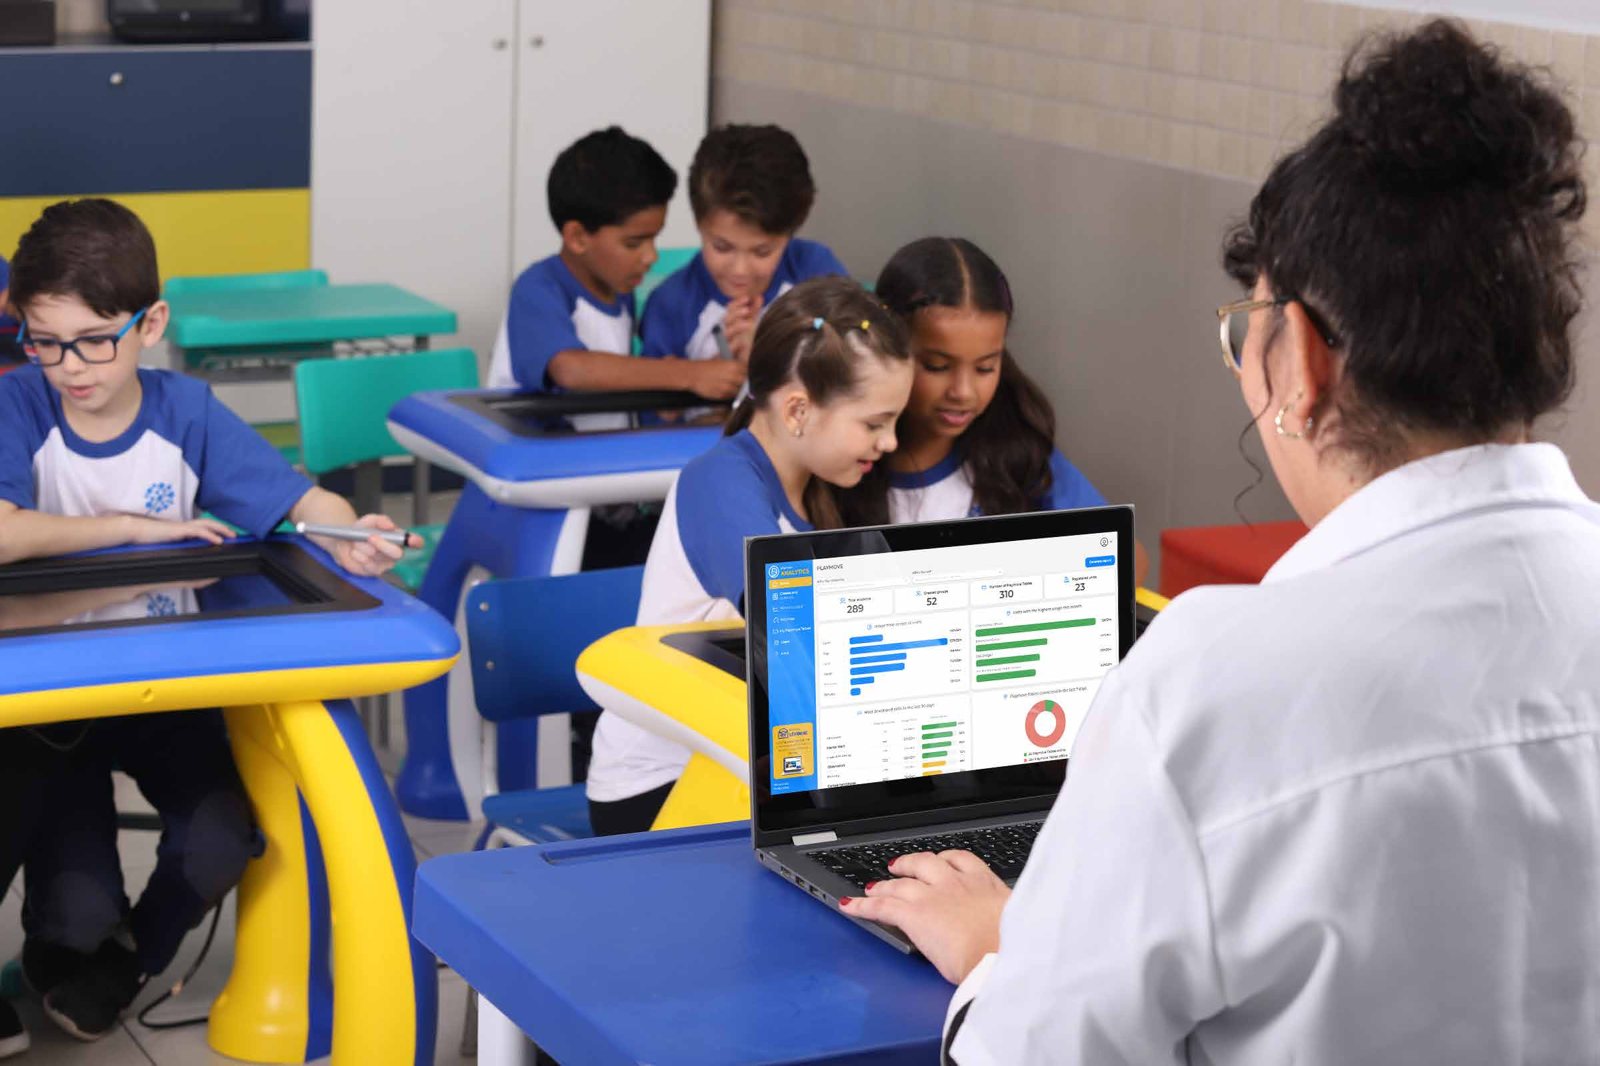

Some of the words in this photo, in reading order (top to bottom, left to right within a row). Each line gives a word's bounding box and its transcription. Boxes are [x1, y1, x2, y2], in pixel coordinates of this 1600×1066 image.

[816, 563, 844, 571] PLAYMOVE
[1074, 582, 1086, 592] 23
[999, 589, 1014, 599] 310
[926, 596, 938, 606] 52
[846, 603, 865, 614] 289
